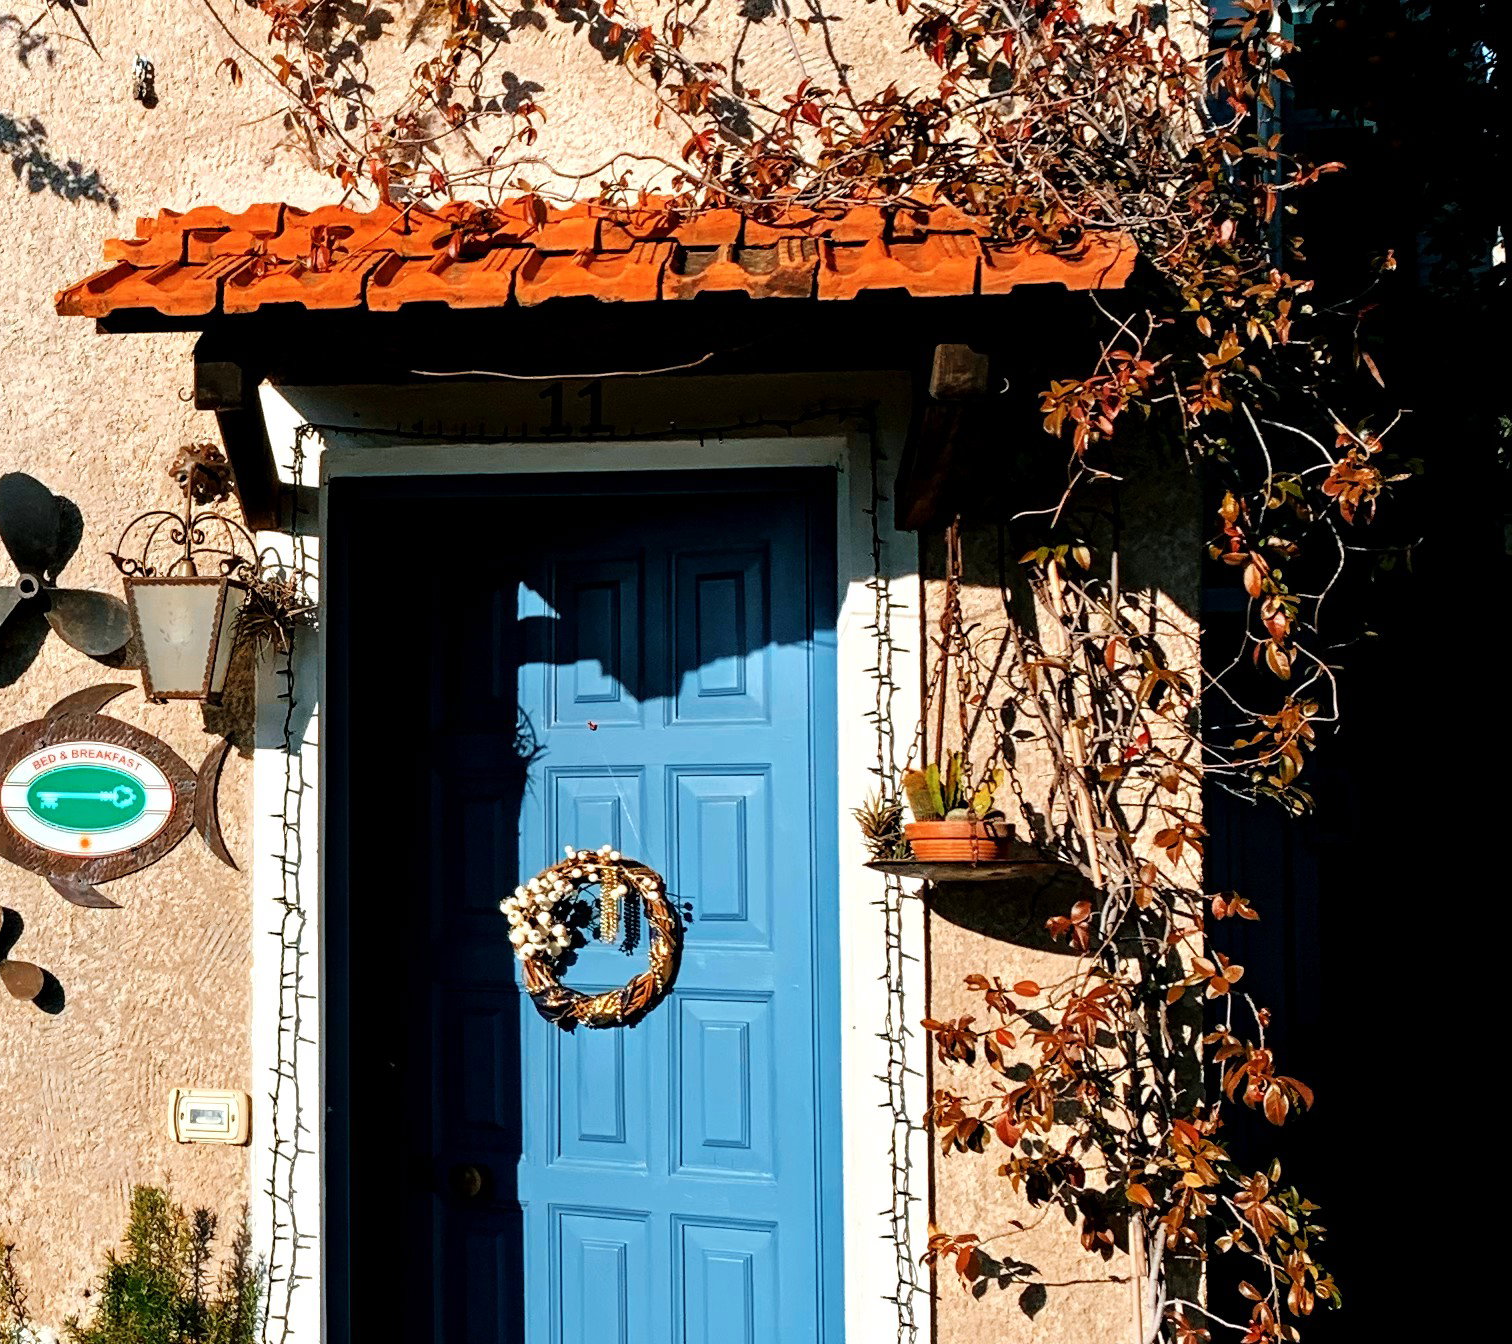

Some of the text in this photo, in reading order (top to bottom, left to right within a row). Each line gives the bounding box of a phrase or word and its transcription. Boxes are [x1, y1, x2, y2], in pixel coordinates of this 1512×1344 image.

[538, 377, 616, 434] 11
[32, 749, 142, 771] BED & BREAKFAST
